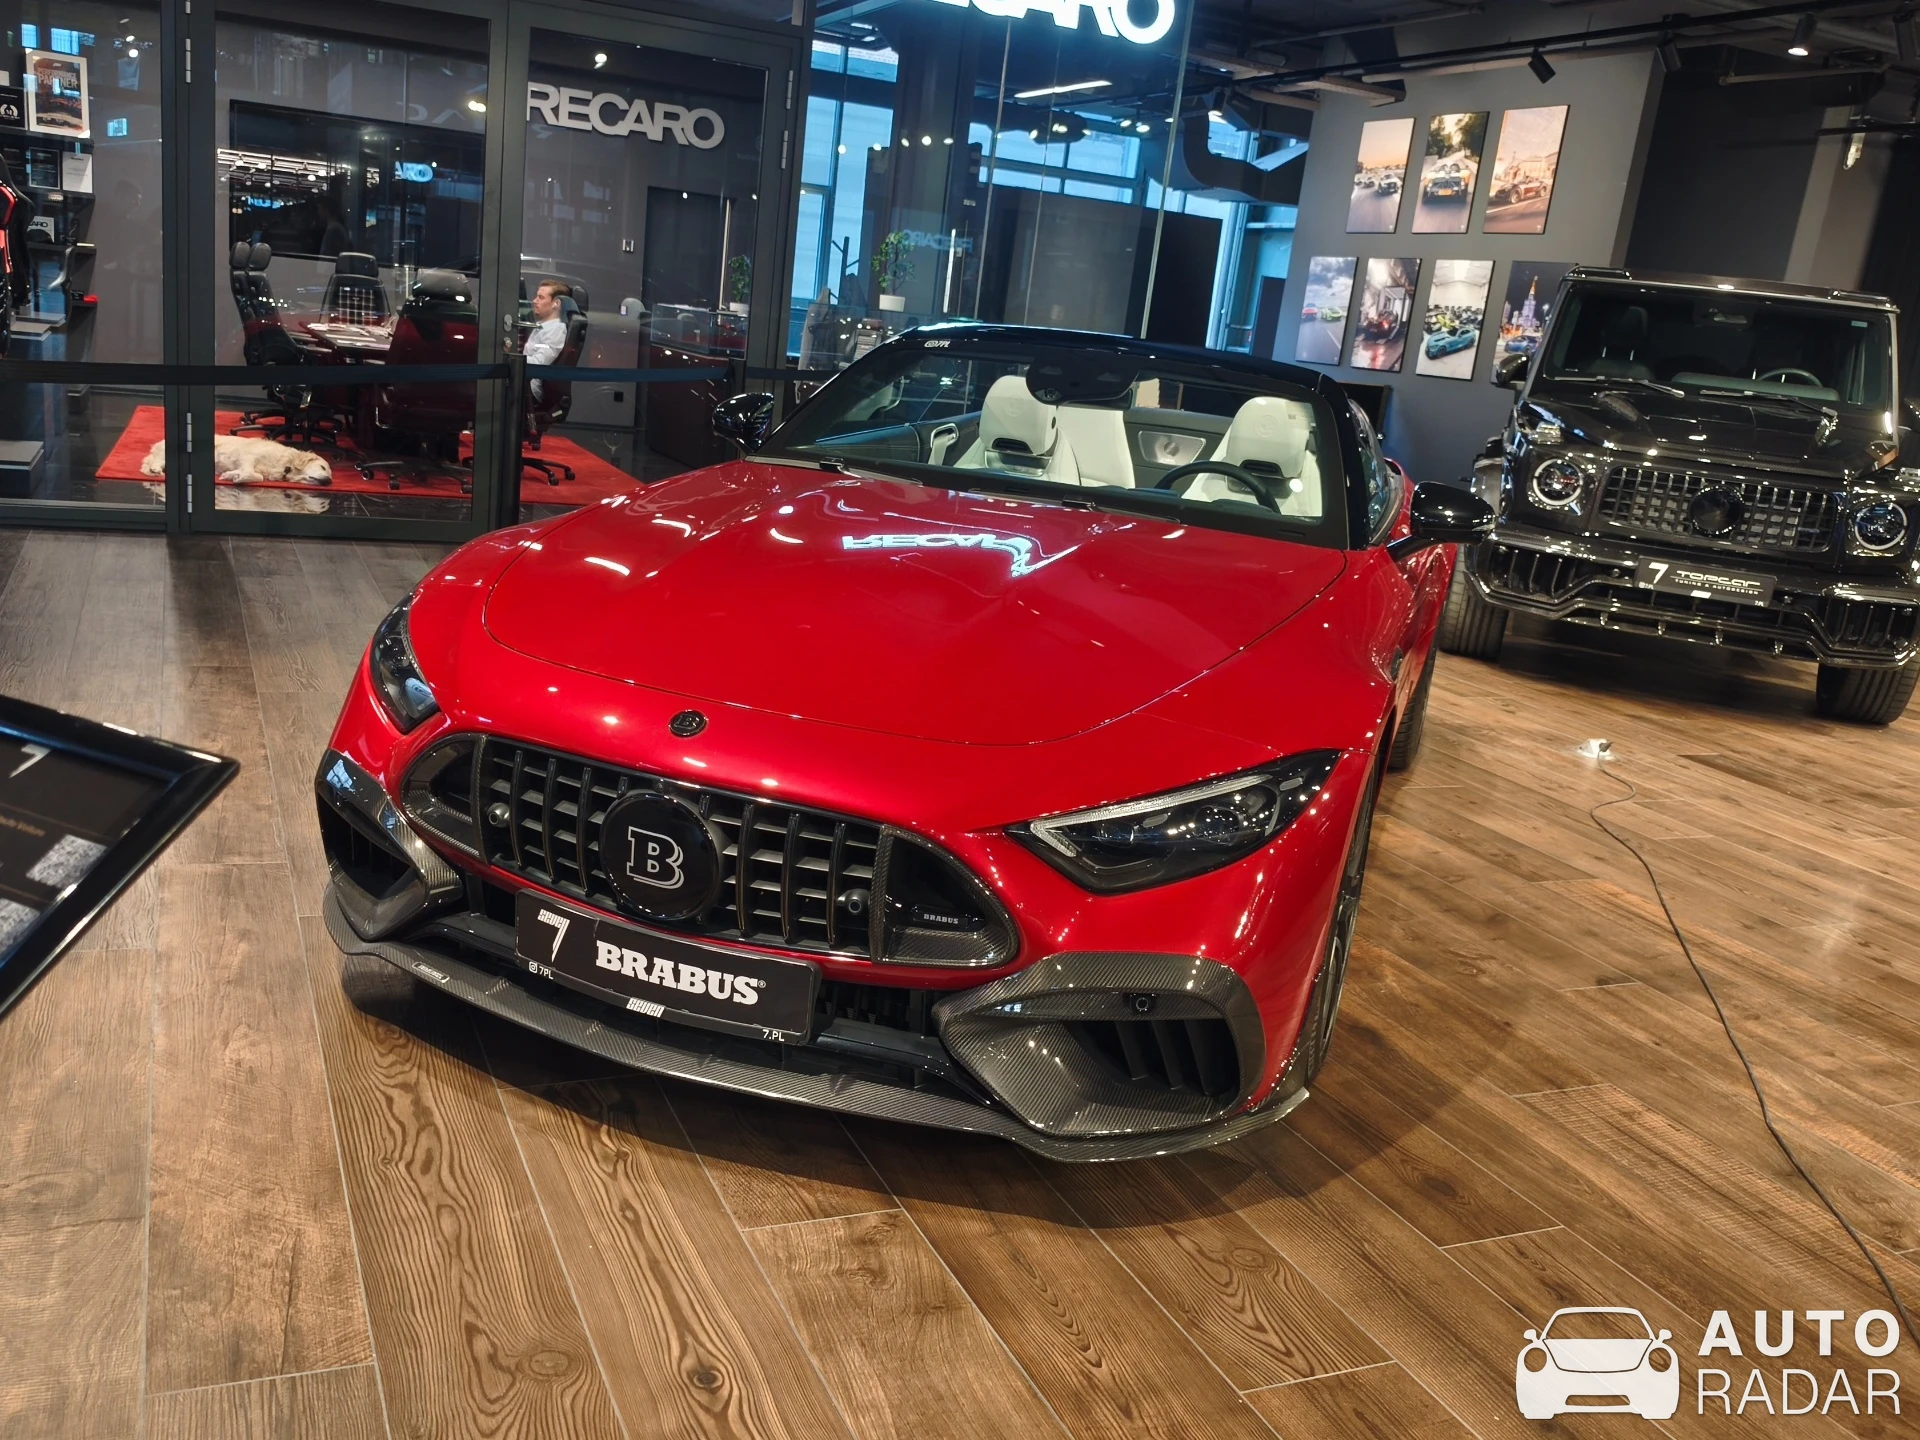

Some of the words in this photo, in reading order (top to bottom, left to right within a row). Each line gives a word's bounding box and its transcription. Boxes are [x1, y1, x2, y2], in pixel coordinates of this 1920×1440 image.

[526, 81, 725, 149] RECARO
[1648, 562, 1669, 584] 7
[627, 826, 684, 889] B
[923, 913, 959, 925] BRABUS
[538, 965, 554, 980] 7PL
[762, 1028, 785, 1043] 7.PL
